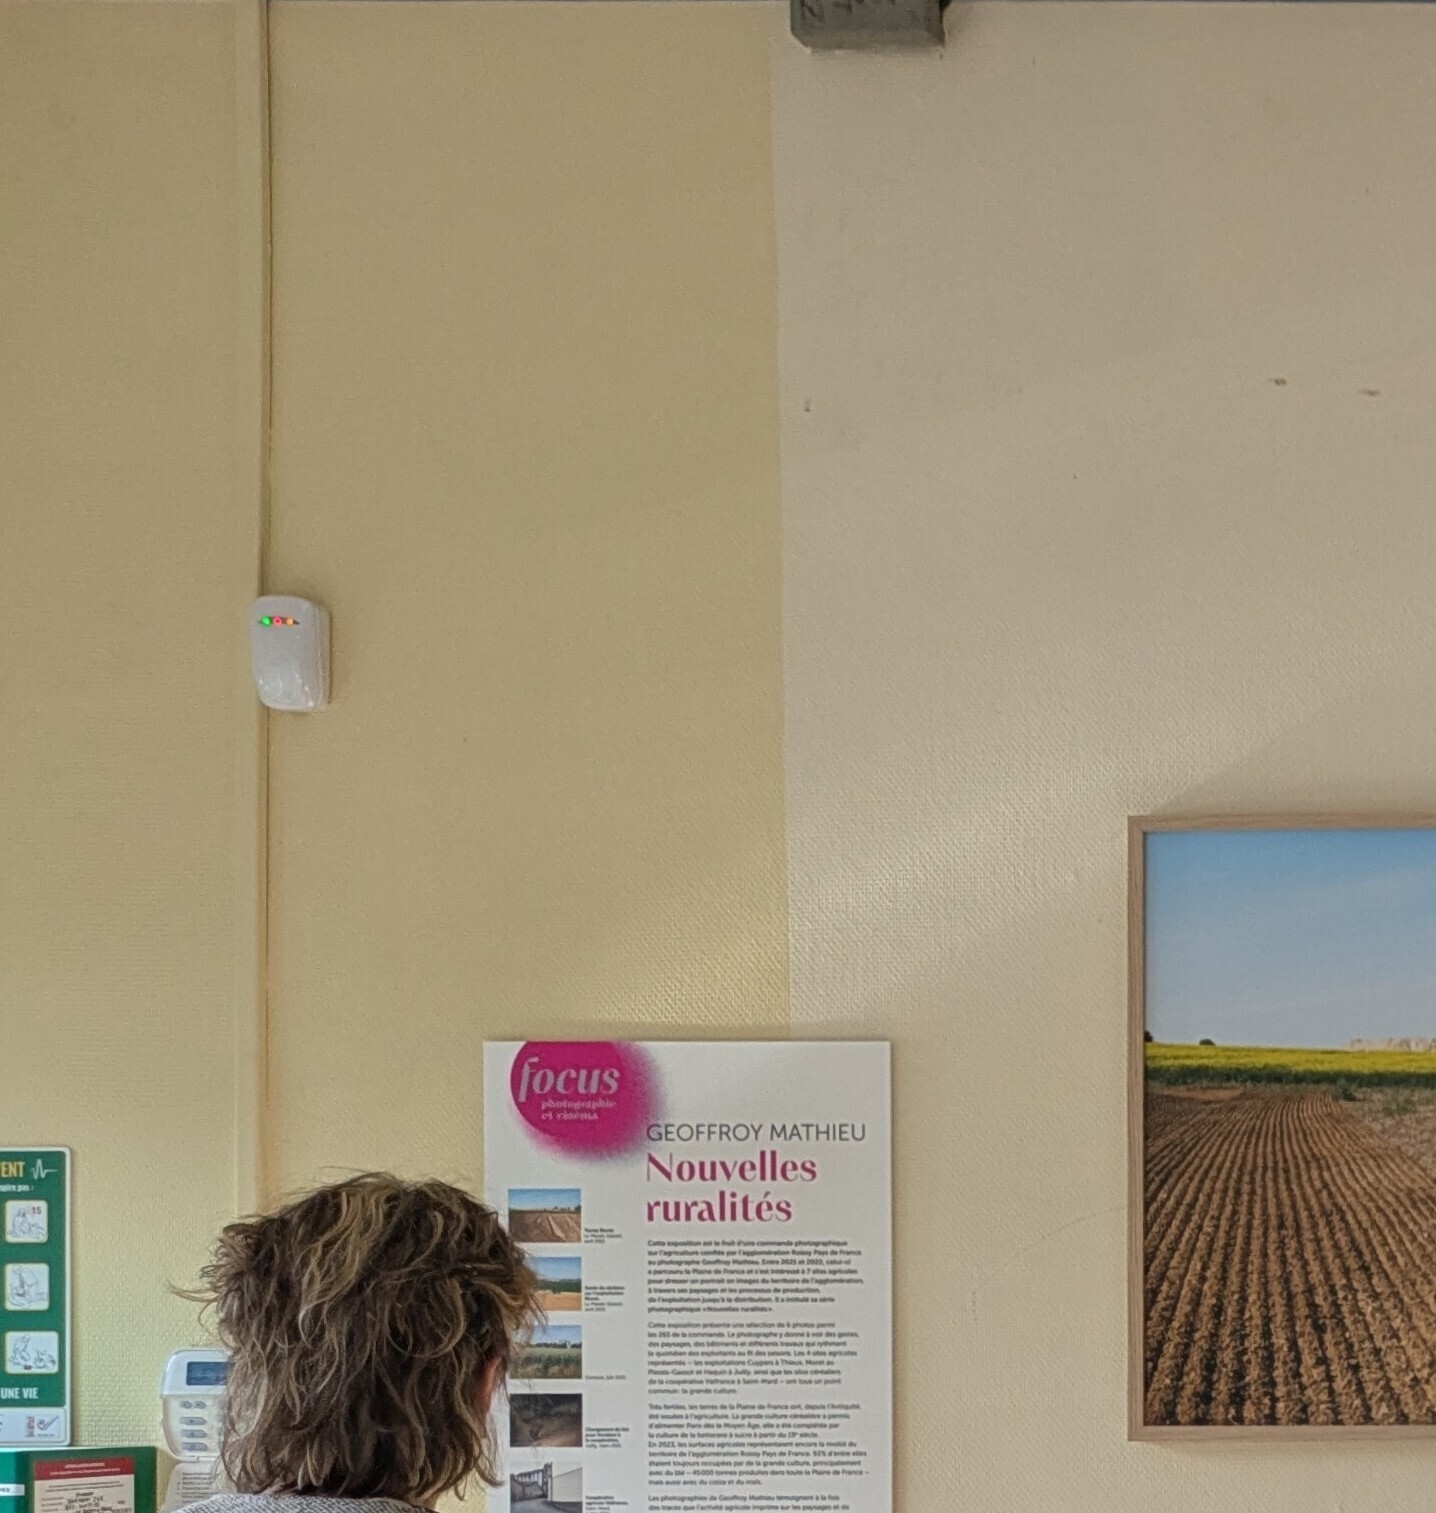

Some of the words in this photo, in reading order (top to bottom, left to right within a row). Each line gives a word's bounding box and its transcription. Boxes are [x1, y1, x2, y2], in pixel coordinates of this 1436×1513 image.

[518, 1056, 621, 1103] focus
[647, 1123, 764, 1142] GEOFFROY
[769, 1124, 866, 1142] MATHIEU
[646, 1150, 818, 1182] Nouvelles
[647, 1190, 793, 1222] ruralités
[0, 1387, 20, 1399] UNE
[22, 1387, 39, 1399] VIE
